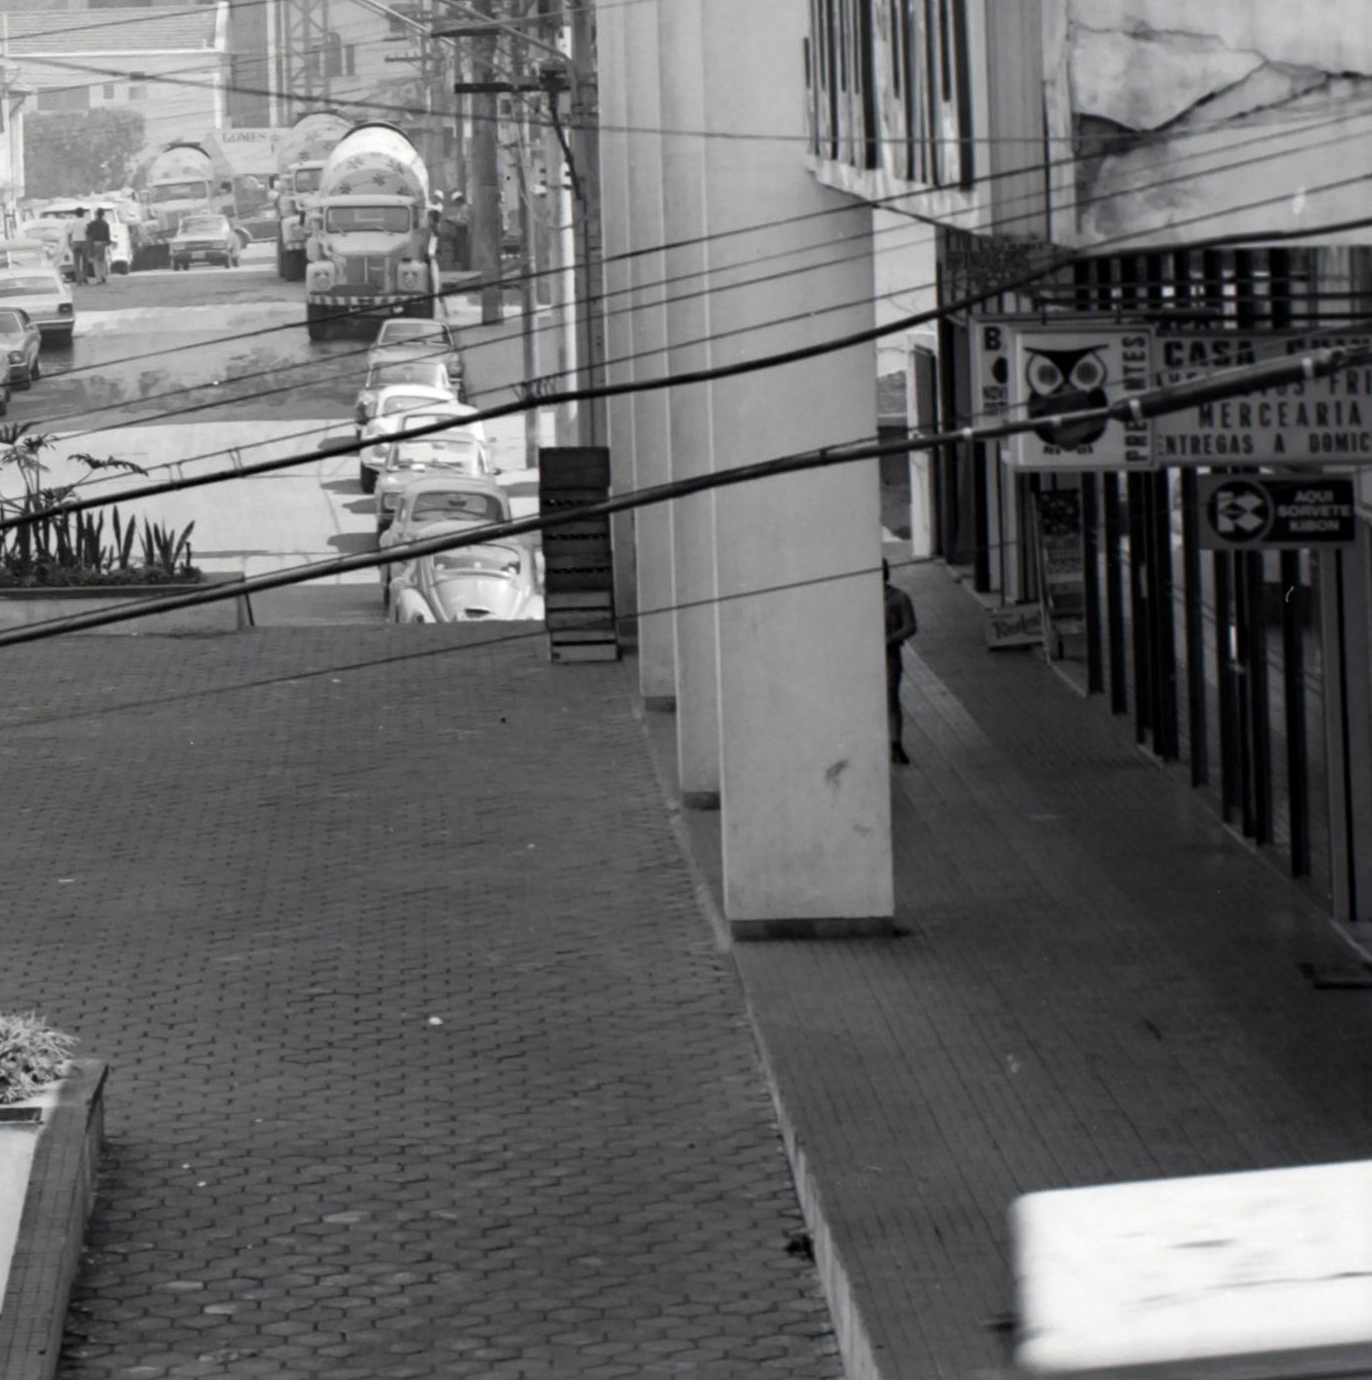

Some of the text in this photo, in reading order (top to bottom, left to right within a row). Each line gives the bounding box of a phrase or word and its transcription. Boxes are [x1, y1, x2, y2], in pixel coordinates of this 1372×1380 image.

[1163, 340, 1255, 368] CASA
[1122, 336, 1147, 462] PRENTES
[1198, 402, 1362, 428] MERCEARIA
[1274, 433, 1286, 453] A
[1294, 489, 1334, 503] AQUI
[1276, 504, 1352, 518] SORVETE
[1289, 518, 1341, 532] KIBON
